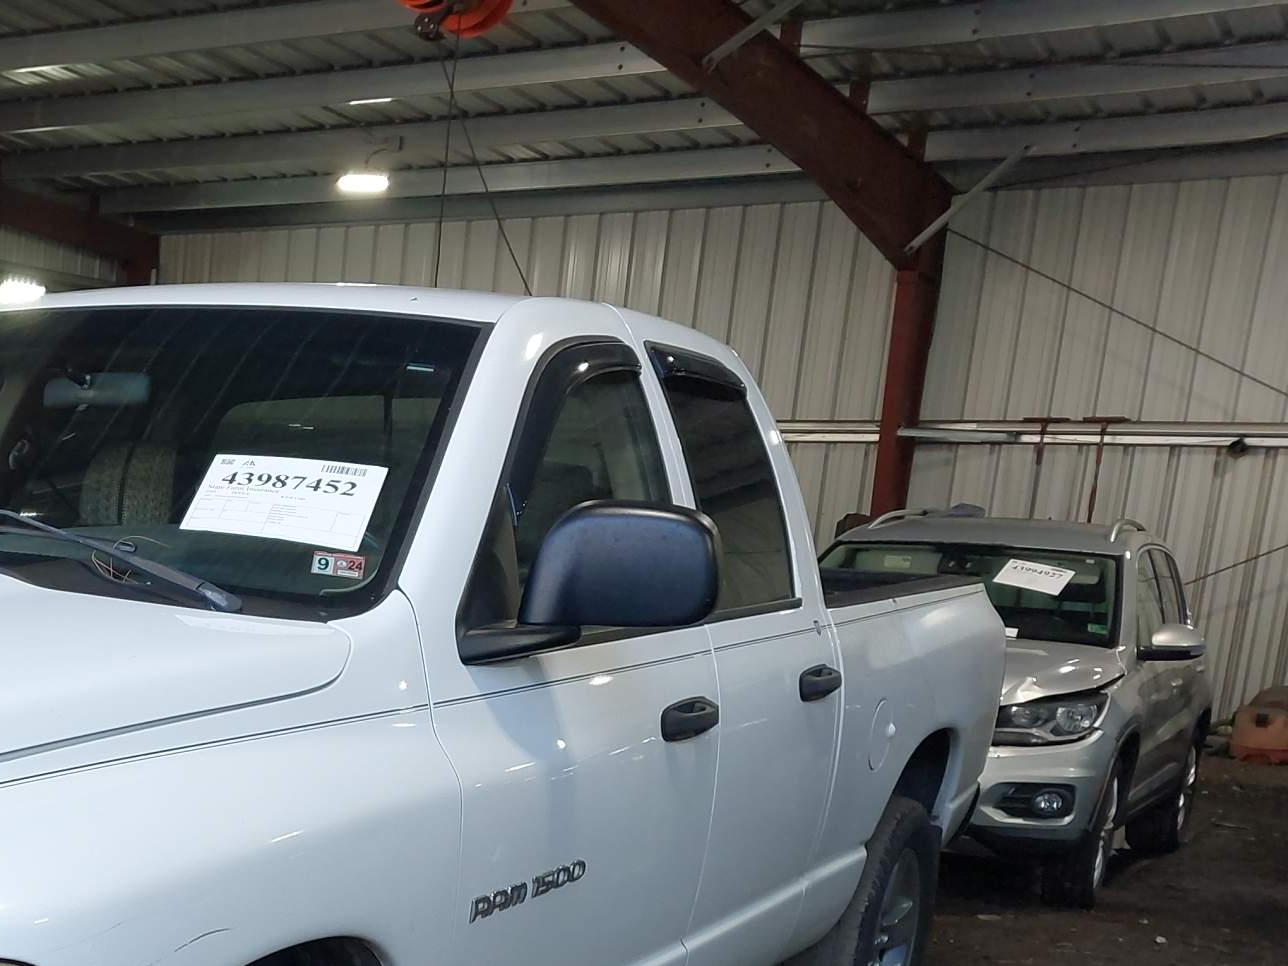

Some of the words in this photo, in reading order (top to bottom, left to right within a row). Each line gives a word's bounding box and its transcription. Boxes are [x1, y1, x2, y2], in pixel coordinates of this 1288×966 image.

[221, 471, 358, 497] 43987452
[317, 557, 330, 571] 9
[348, 560, 363, 571] 24
[469, 882, 528, 924] RAM
[531, 859, 586, 899] 1500
